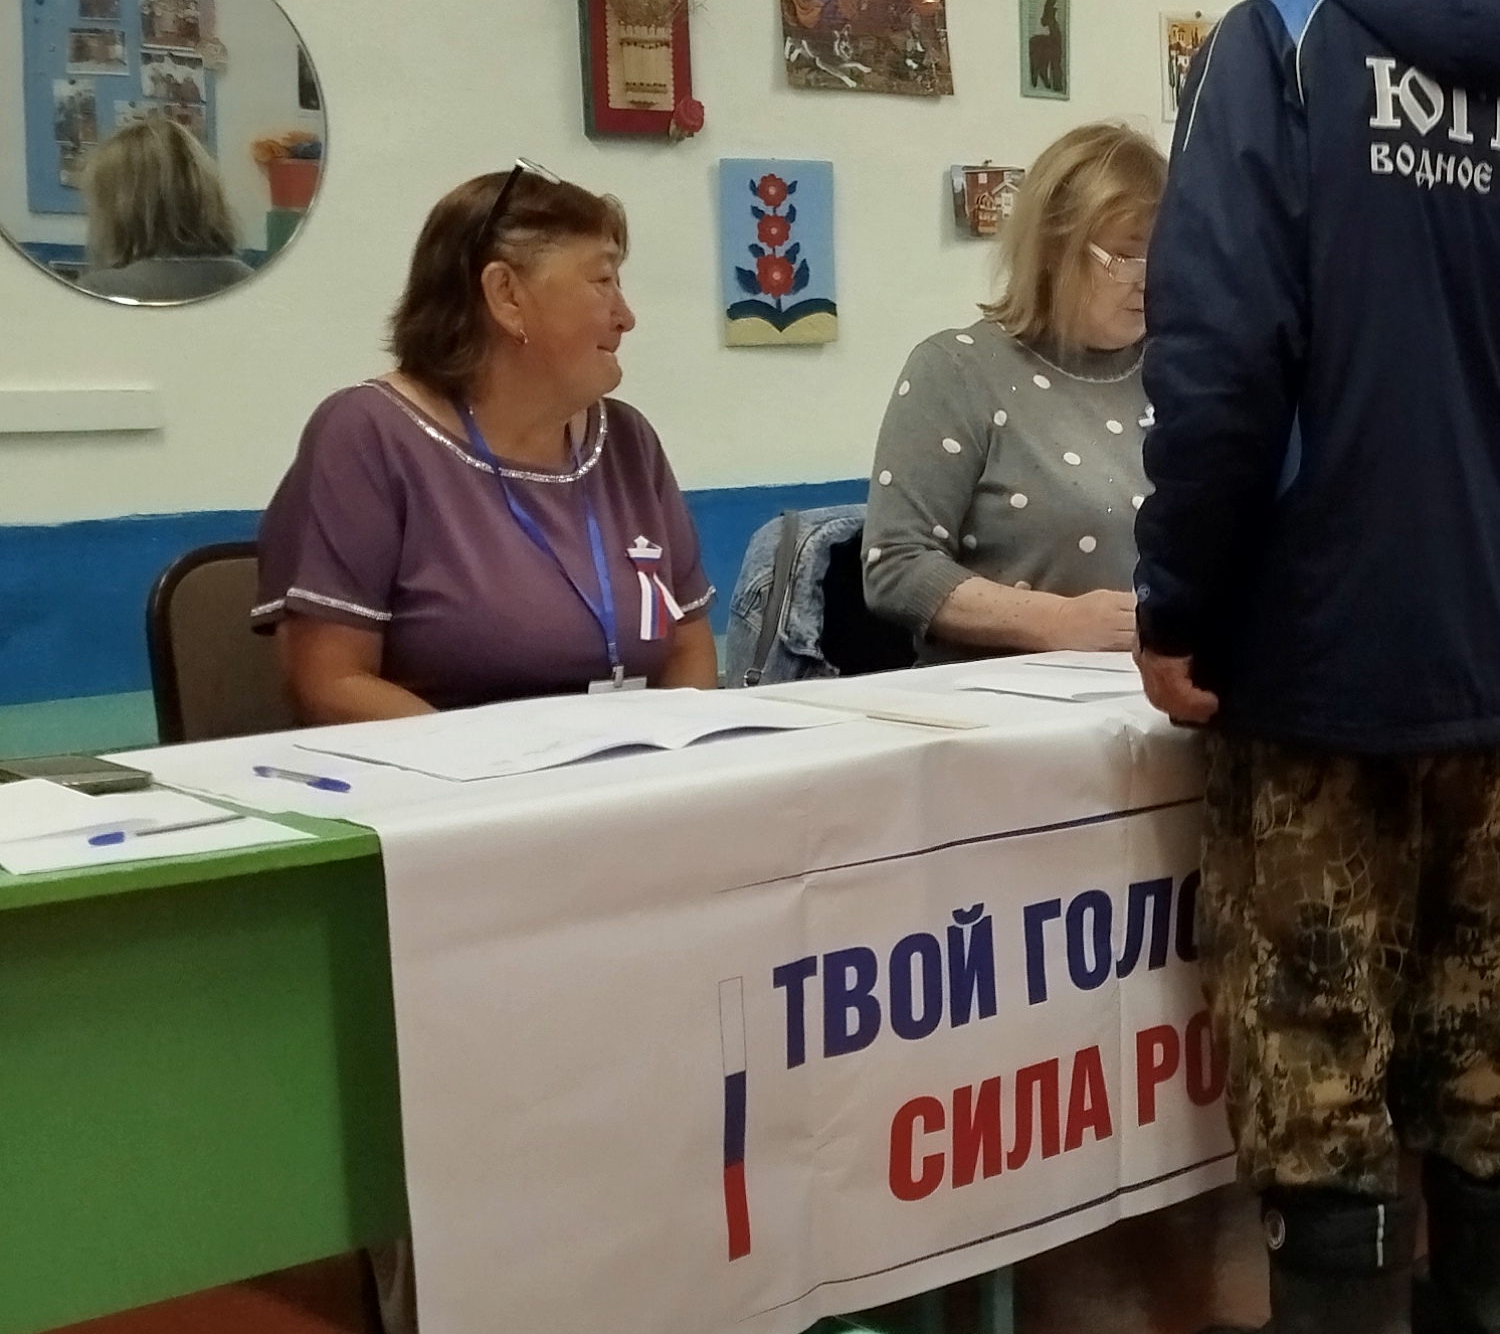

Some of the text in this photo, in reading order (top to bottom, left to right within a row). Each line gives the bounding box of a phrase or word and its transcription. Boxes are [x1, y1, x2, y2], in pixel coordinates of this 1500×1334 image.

[1370, 142, 1493, 195] ВОДНОЕ
[773, 902, 997, 1069] ТВОЙ
[888, 1044, 1113, 1202] СИЛА
